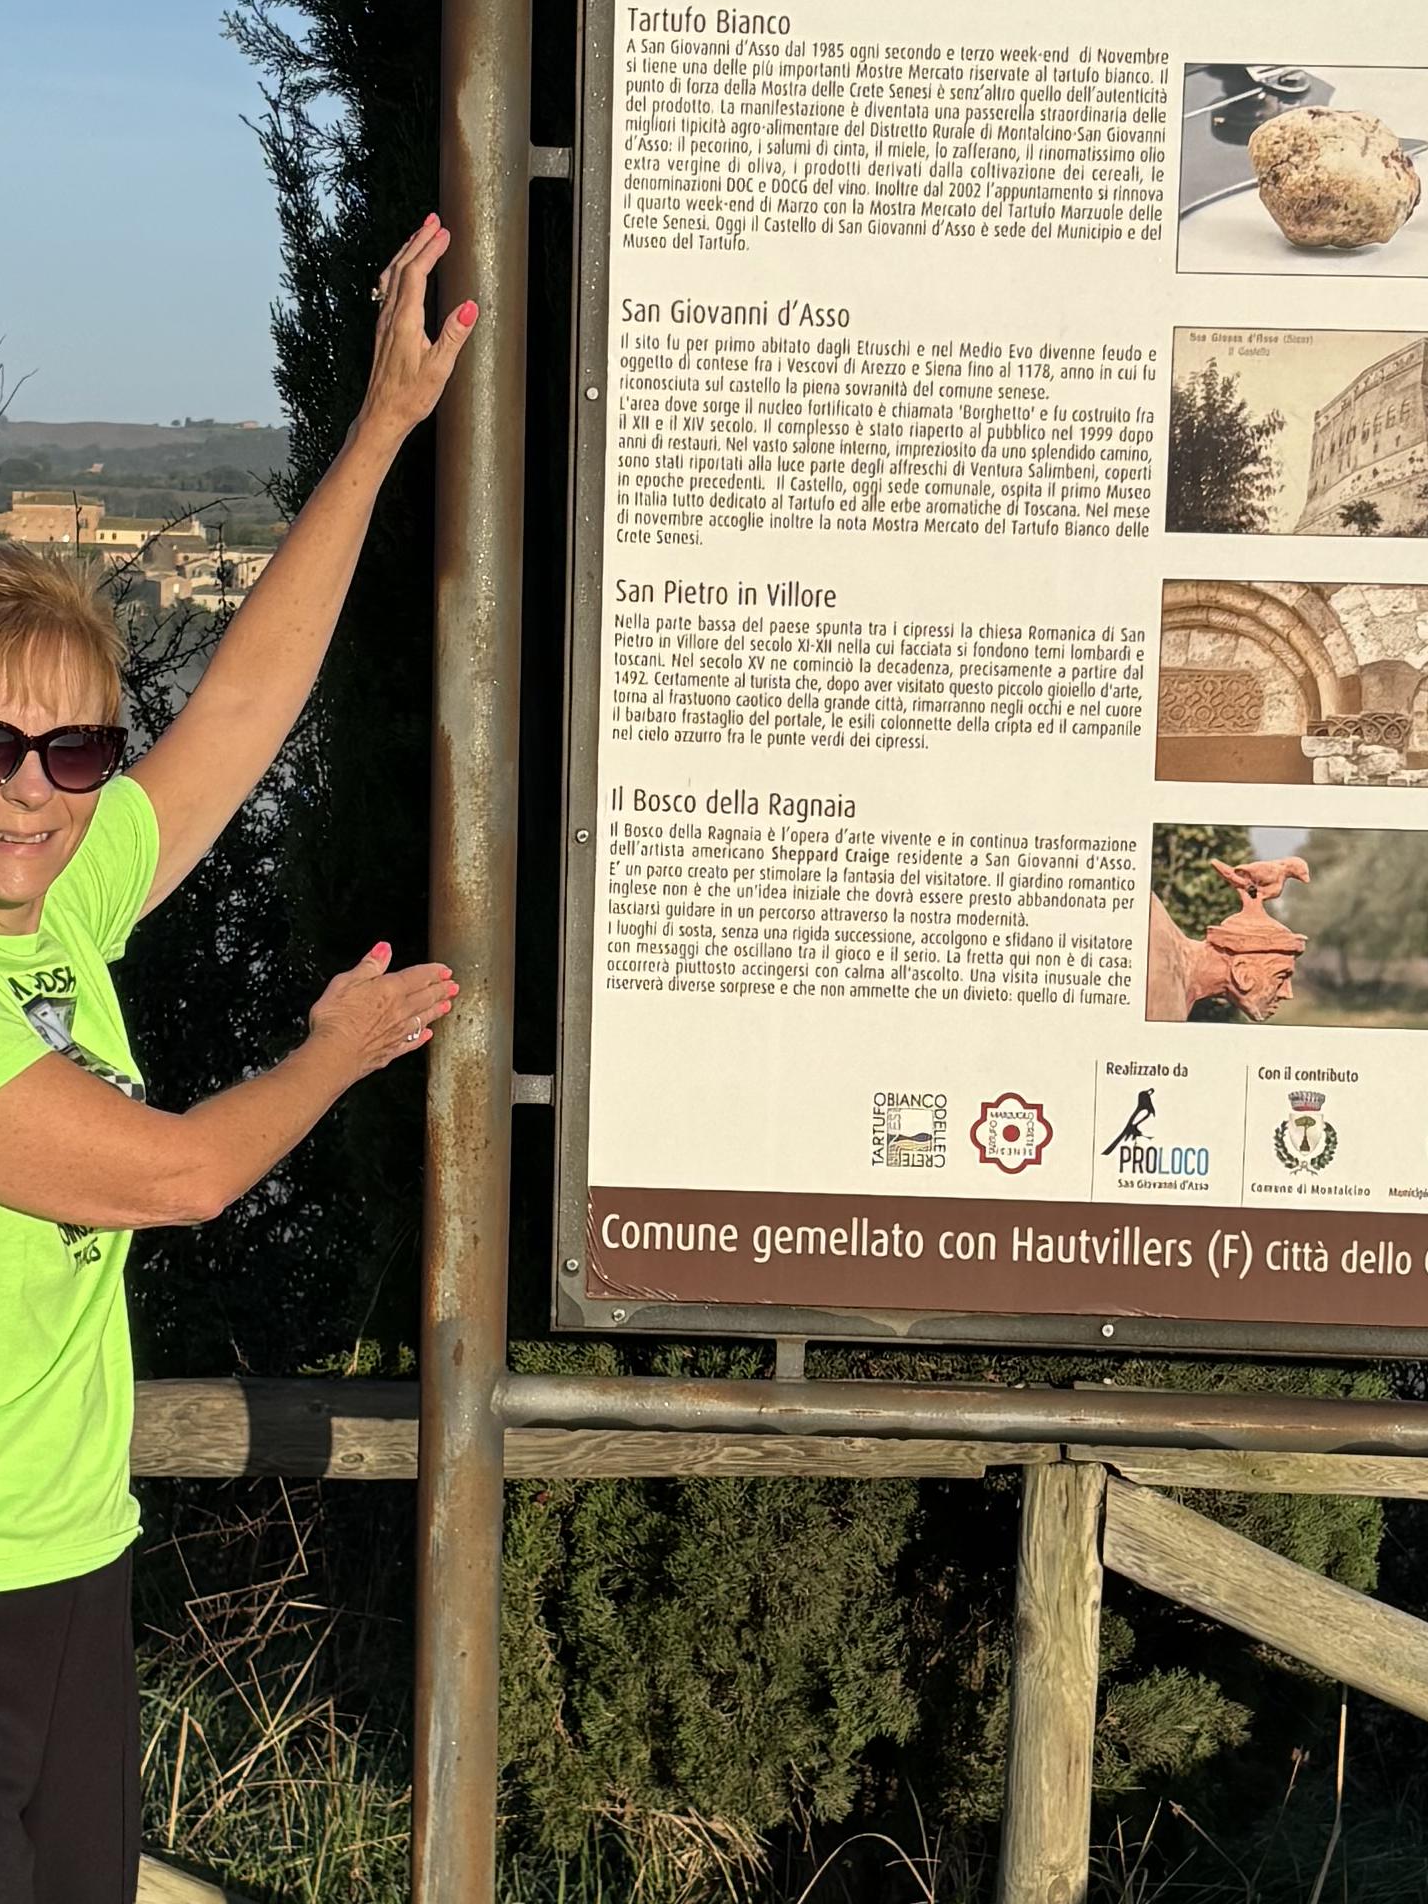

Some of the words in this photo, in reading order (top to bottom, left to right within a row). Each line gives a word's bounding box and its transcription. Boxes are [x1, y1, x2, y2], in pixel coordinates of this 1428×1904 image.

[627, 6, 706, 33] Tartufo
[716, 8, 790, 35] Bianco
[623, 233, 666, 248] Museo
[672, 233, 693, 249] del
[622, 298, 659, 322] San
[671, 298, 767, 325] Giovanni
[778, 299, 849, 327] d'Asso
[616, 528, 650, 543] Crete
[616, 578, 653, 602] San
[664, 579, 727, 605] Pietro
[738, 581, 756, 605] in
[767, 580, 836, 608] Villore
[612, 727, 632, 740] nel
[638, 727, 669, 741] cielo
[674, 730, 721, 743] azzurro
[727, 729, 744, 744] fra
[750, 729, 762, 744] le
[767, 731, 805, 748] punte
[811, 731, 844, 746] verdi
[849, 731, 870, 747] dei
[612, 786, 622, 811] Il
[634, 788, 696, 813] Bosco
[706, 788, 758, 815] della
[769, 792, 855, 820] Ragnaia
[608, 900, 659, 915] lasciarsi
[665, 902, 715, 920] guidare
[720, 903, 732, 917] in
[738, 907, 754, 918] un
[759, 907, 815, 922] percorso
[820, 907, 888, 922] attraverso
[893, 907, 904, 923] la
[910, 911, 951, 924] nostra
[1106, 1061, 1169, 1076] Realizzato
[1172, 1062, 1188, 1077] da
[1258, 1066, 1280, 1080] Con
[1284, 1066, 1291, 1080] il
[1294, 1067, 1358, 1082] contributo
[1119, 1142, 1208, 1175] PROLOCO
[601, 1213, 738, 1252] Comune
[753, 1216, 923, 1260] gemellato
[939, 1231, 995, 1260] con
[1012, 1226, 1192, 1267] Hautvillers
[1208, 1229, 1252, 1279] (F)
[1266, 1239, 1328, 1272] Città
[1341, 1240, 1411, 1274] dello
